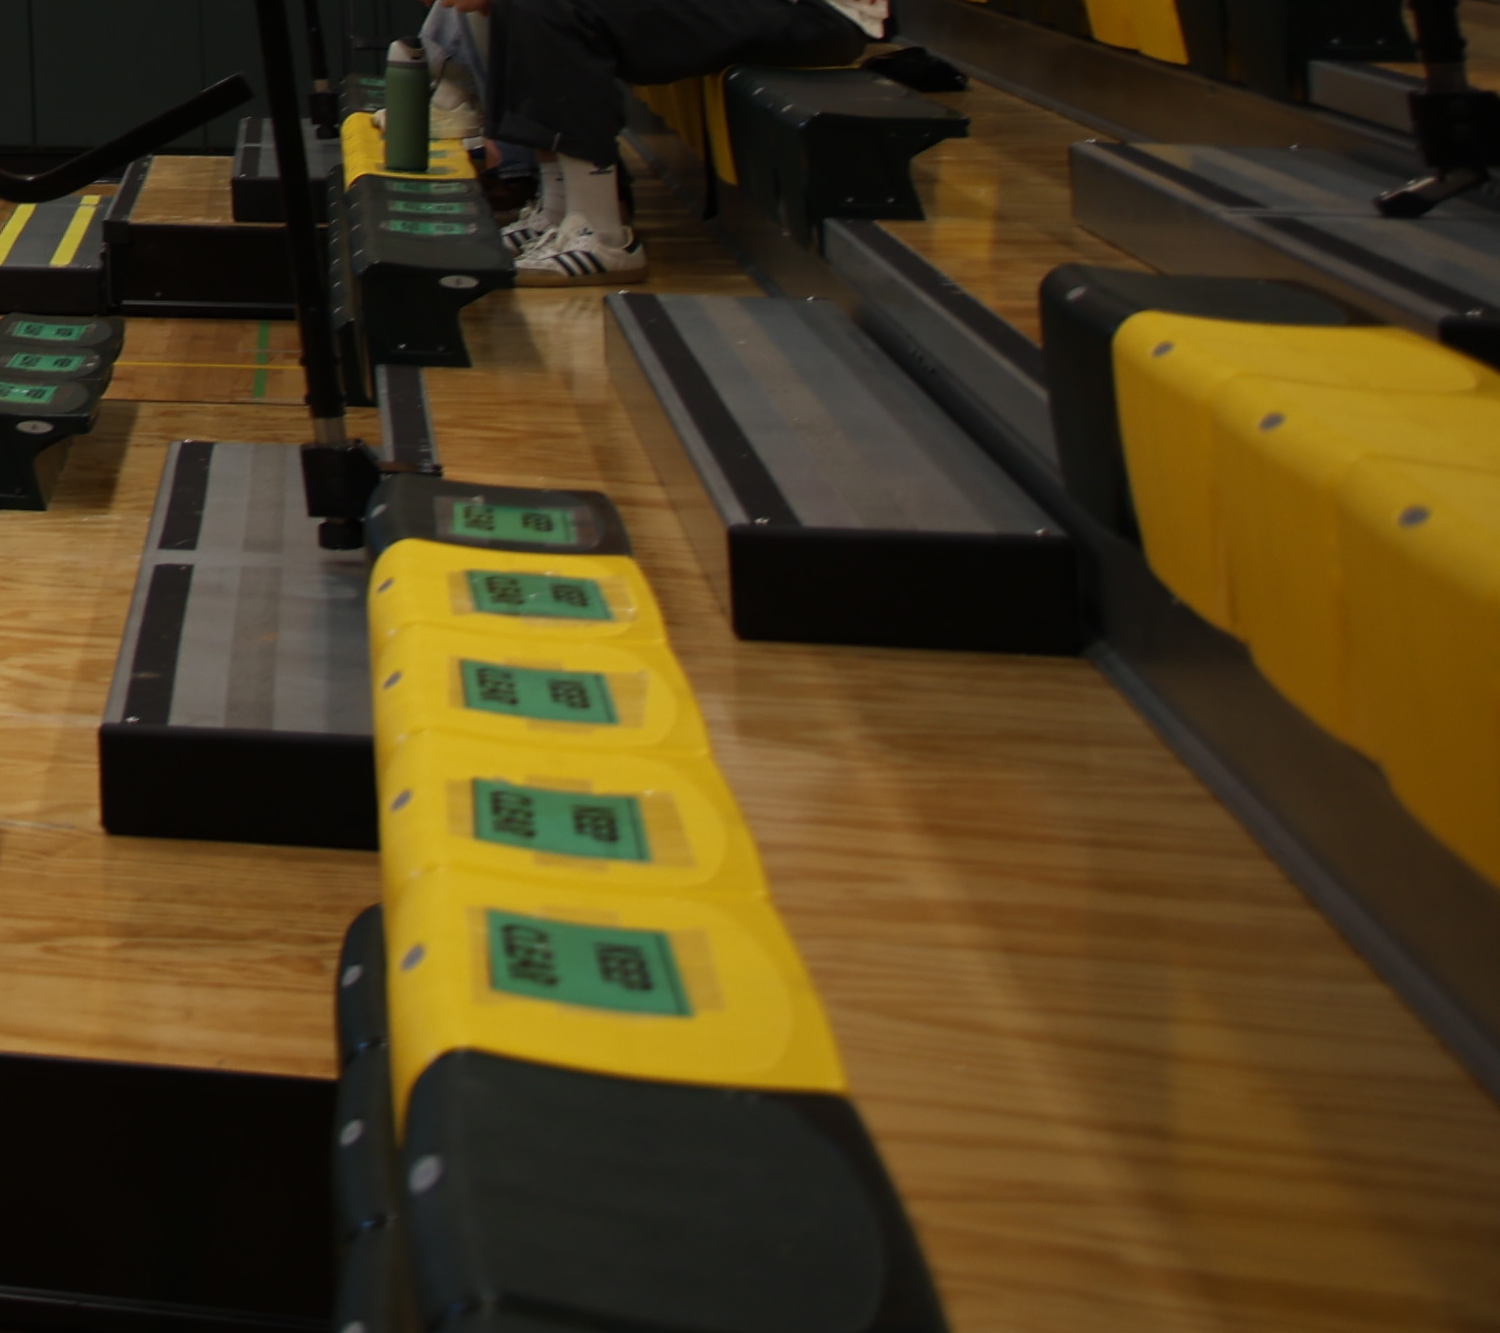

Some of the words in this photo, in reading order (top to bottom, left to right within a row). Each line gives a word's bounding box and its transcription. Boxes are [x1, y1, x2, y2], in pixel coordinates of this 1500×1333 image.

[549, 583, 589, 608] KEEP
[547, 679, 591, 710] KEEP
[489, 790, 537, 839] CLEAR
[570, 804, 620, 843] KEEP
[500, 924, 560, 989] CLEAR
[593, 941, 655, 992] KEEP
